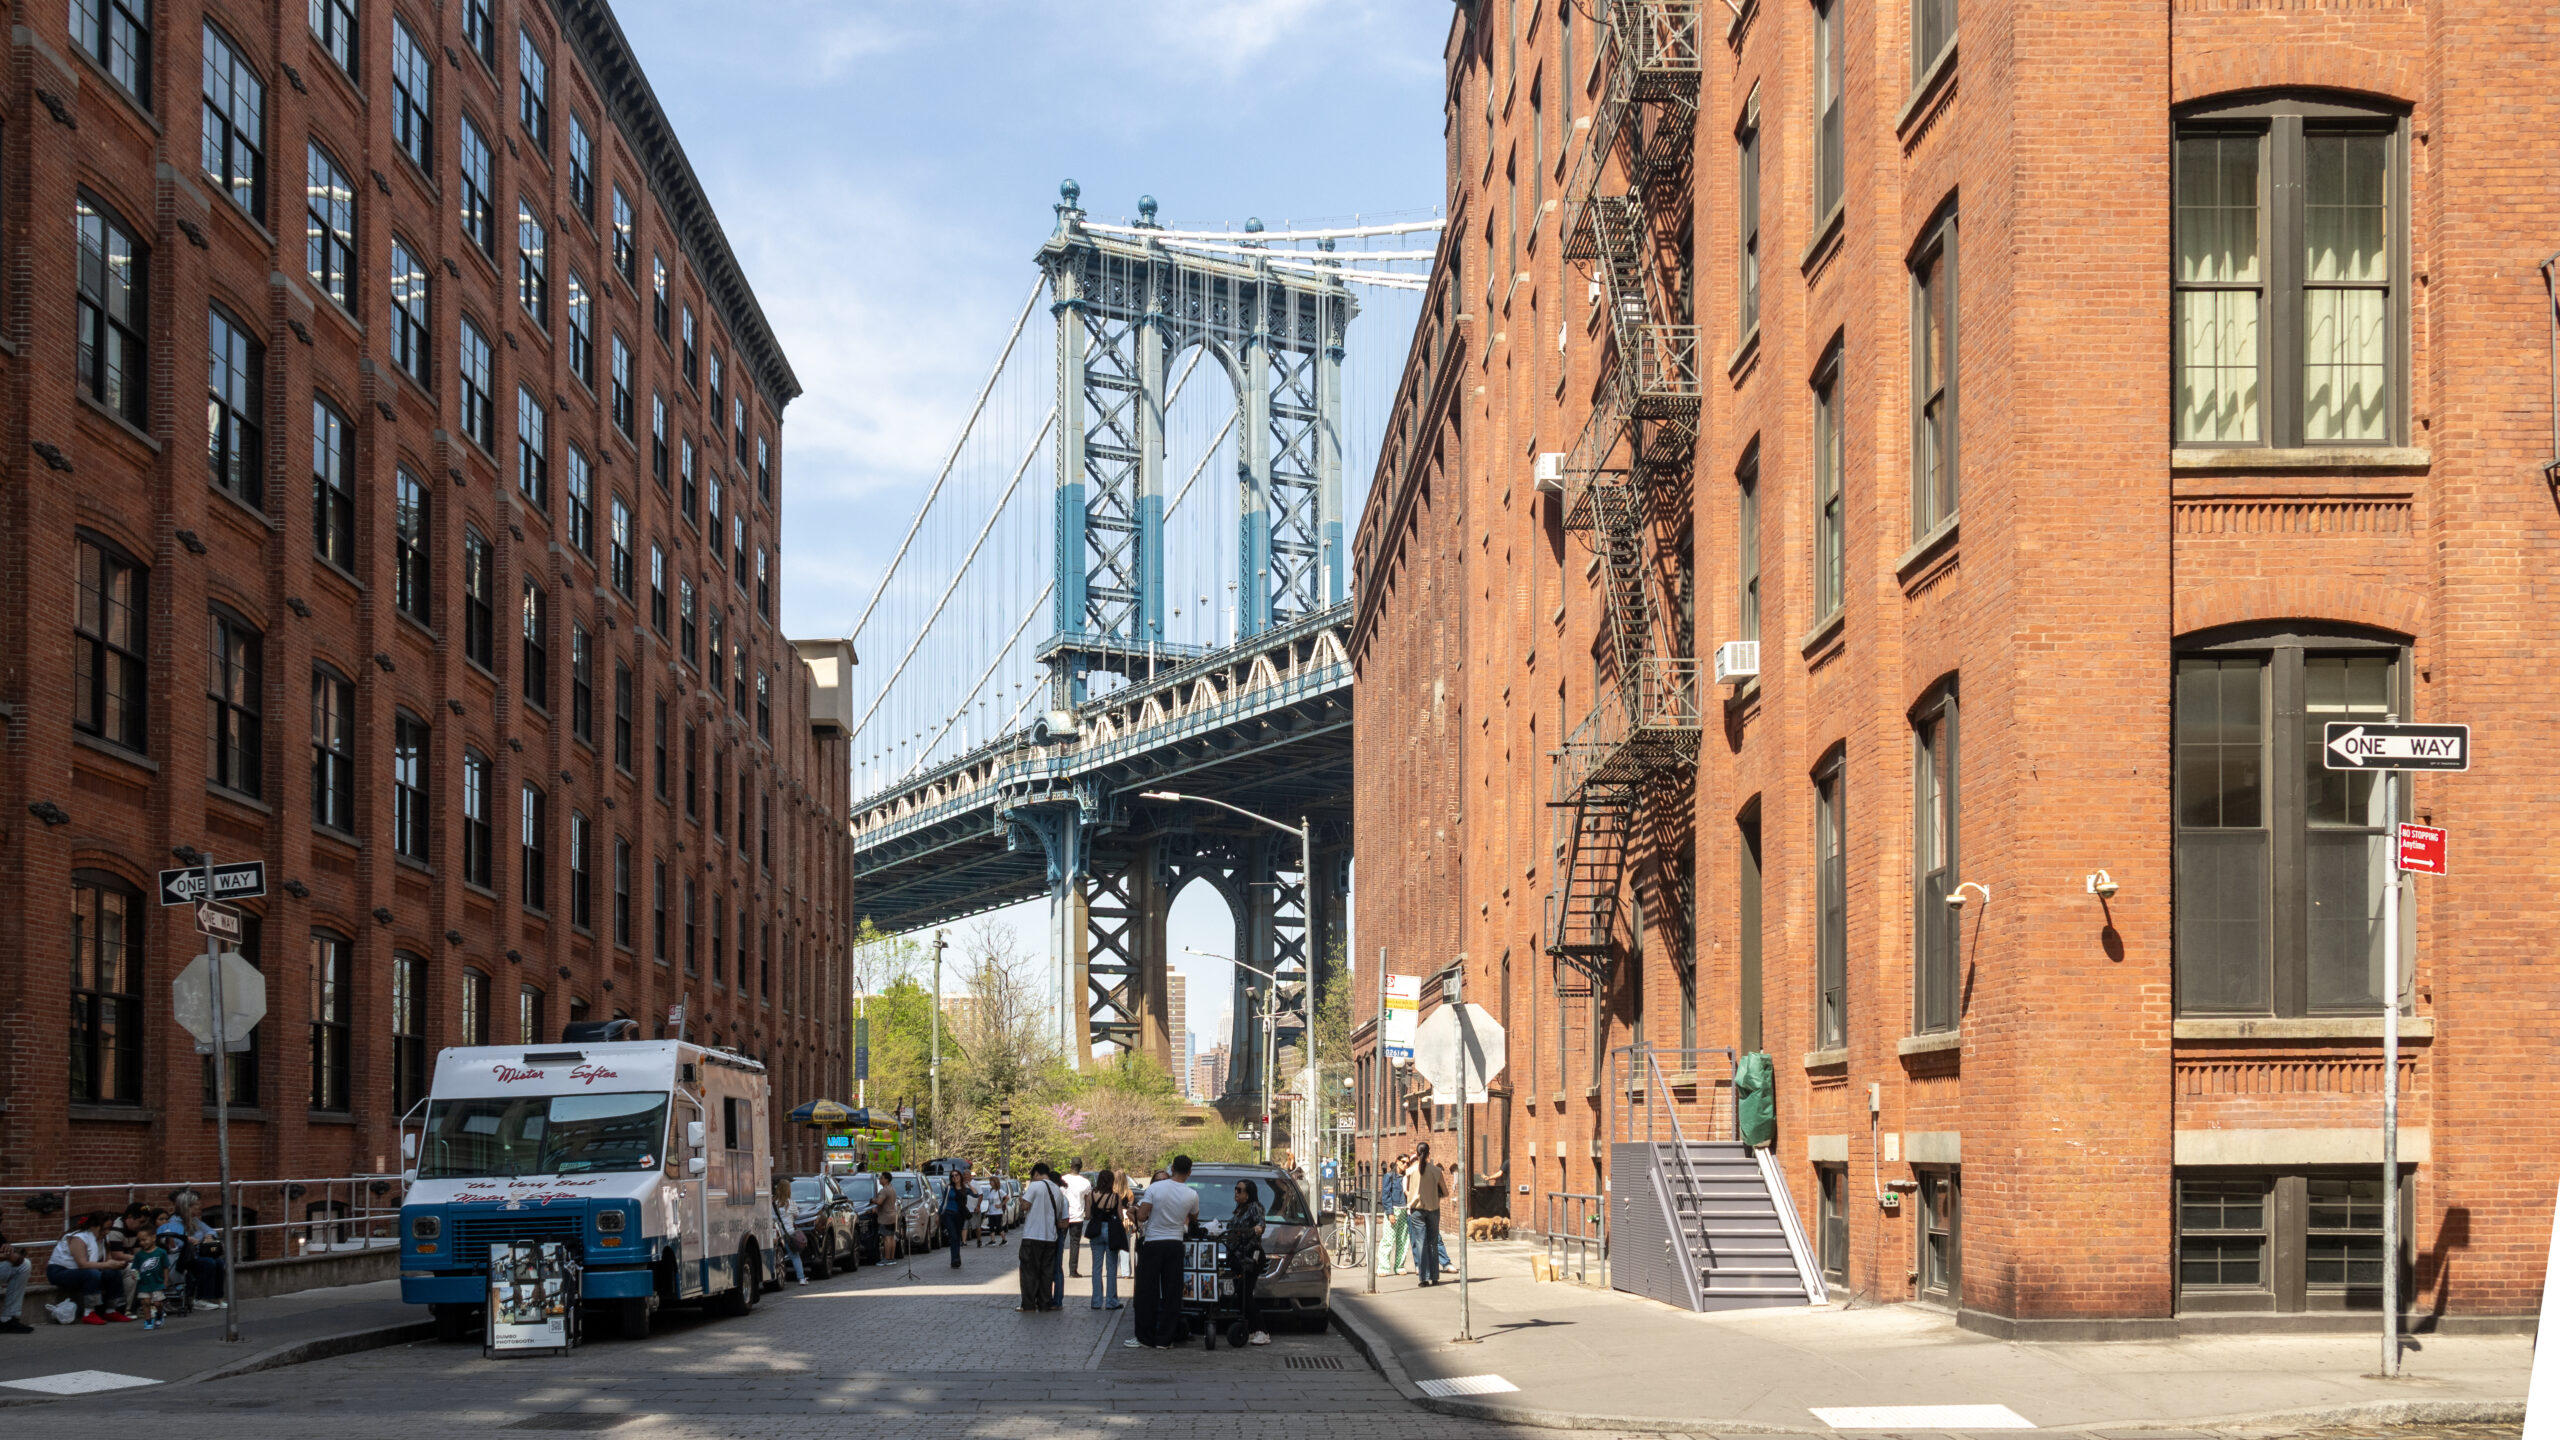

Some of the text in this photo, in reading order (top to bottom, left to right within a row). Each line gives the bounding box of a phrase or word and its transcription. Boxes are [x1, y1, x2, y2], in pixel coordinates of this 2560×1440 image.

[2345, 737, 2455, 756] ONE WAY
[2402, 829, 2439, 842] NO STOPPING
[2402, 839, 2426, 850] Anytime
[177, 873, 250, 893] ONE WAY
[202, 909, 235, 931] ONE WAY
[492, 1064, 618, 1085] Mister Softee
[1326, 1168, 1332, 1178] P
[508, 1181, 549, 1189] Very
[453, 1191, 577, 1206] Mister Softee
